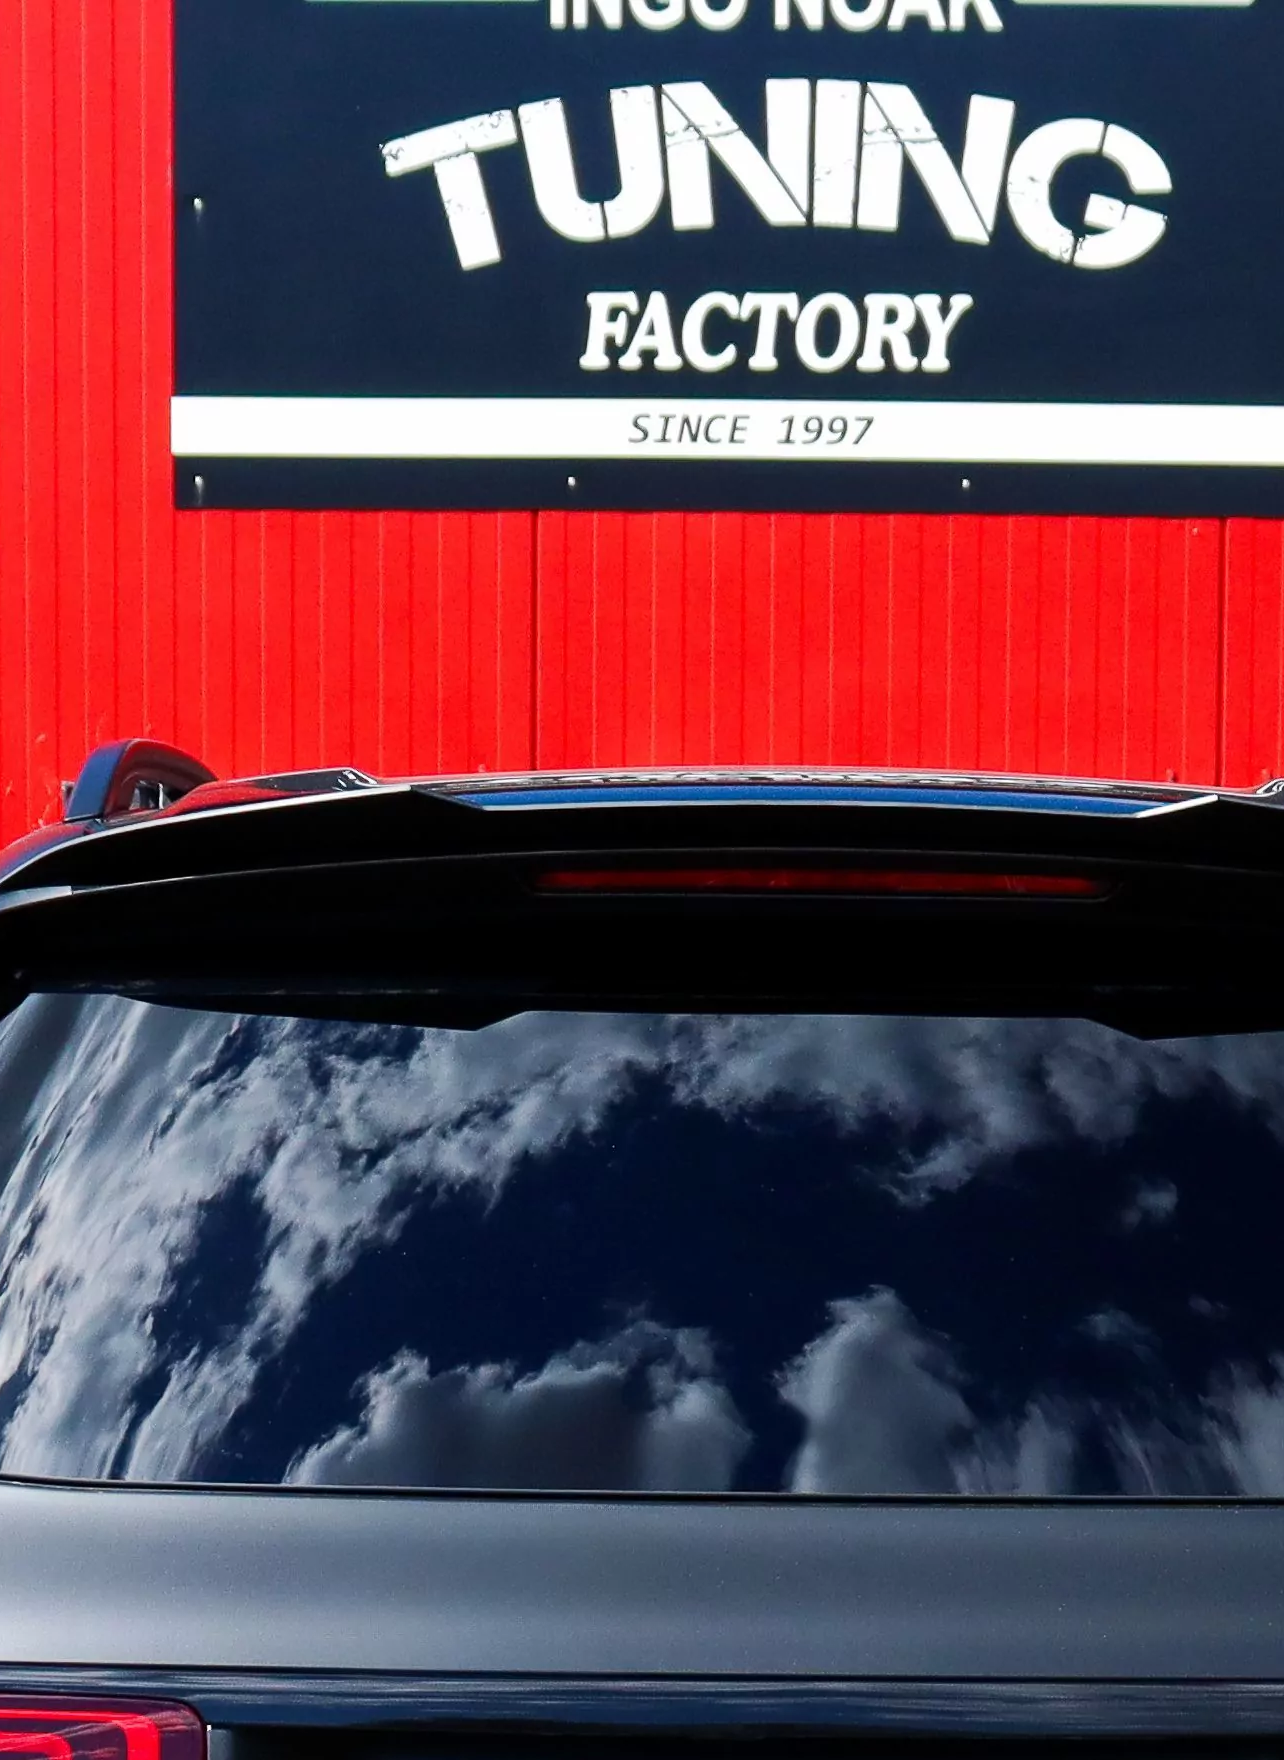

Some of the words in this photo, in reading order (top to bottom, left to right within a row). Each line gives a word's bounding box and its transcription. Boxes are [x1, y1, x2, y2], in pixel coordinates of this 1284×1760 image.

[379, 77, 1173, 271] TUNING
[579, 290, 974, 373] FACTORY
[628, 413, 752, 446] SINCE
[778, 415, 875, 447] 1997
